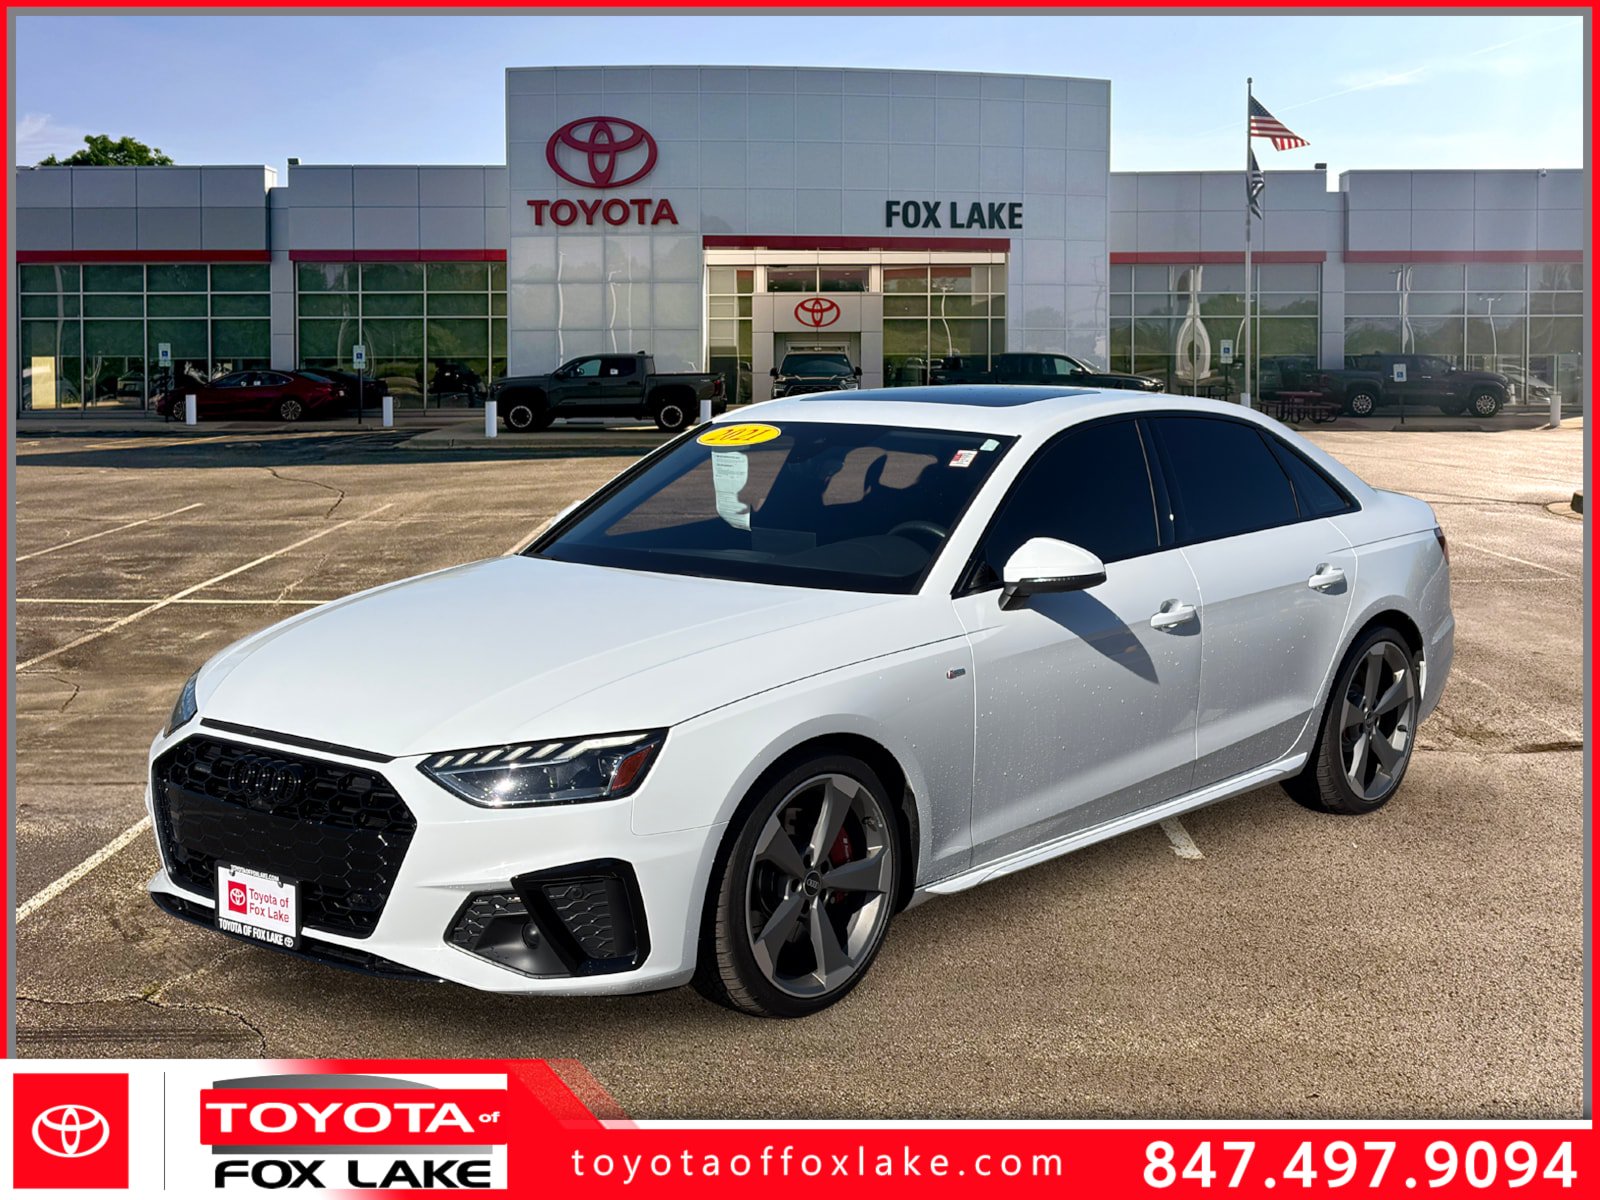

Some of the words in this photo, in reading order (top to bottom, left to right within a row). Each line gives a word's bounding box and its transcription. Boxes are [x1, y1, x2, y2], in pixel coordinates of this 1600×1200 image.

[527, 198, 678, 226] TOYOTA
[885, 200, 942, 229] FOX
[950, 201, 1023, 229] LAKE
[704, 428, 771, 441] 2021
[249, 888, 277, 905] Toyota
[279, 897, 289, 908] of
[249, 903, 266, 917] Fox
[268, 907, 290, 923] Lake
[218, 918, 242, 934] TOYOTA
[243, 926, 252, 937] OF
[252, 928, 267, 941] FOX
[266, 931, 284, 946] LAKE
